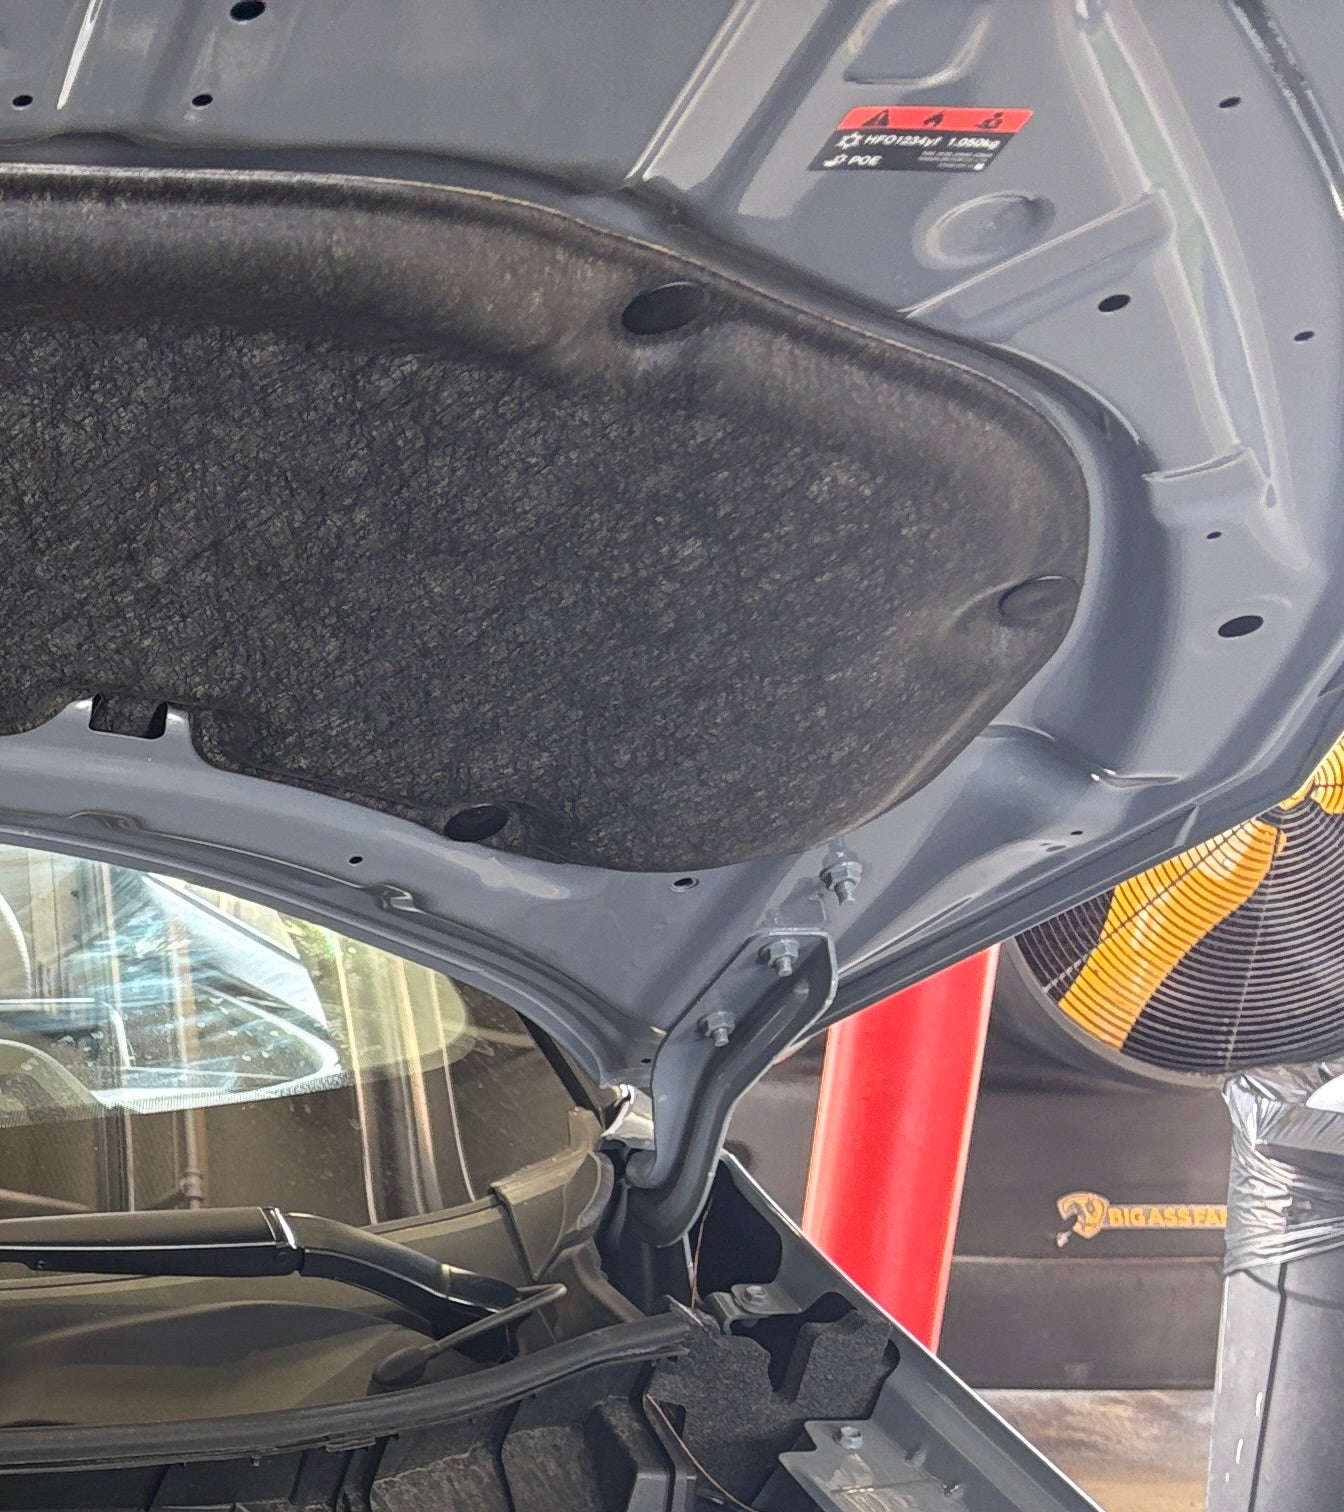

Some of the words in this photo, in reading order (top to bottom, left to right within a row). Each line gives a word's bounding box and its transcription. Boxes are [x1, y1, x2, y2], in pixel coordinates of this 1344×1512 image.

[863, 134, 943, 149] HFO1234yf
[946, 136, 1001, 150] 1.050kg
[847, 154, 883, 167] POE
[1108, 1207, 1145, 1227] BIG
[1148, 1207, 1192, 1227] ASS
